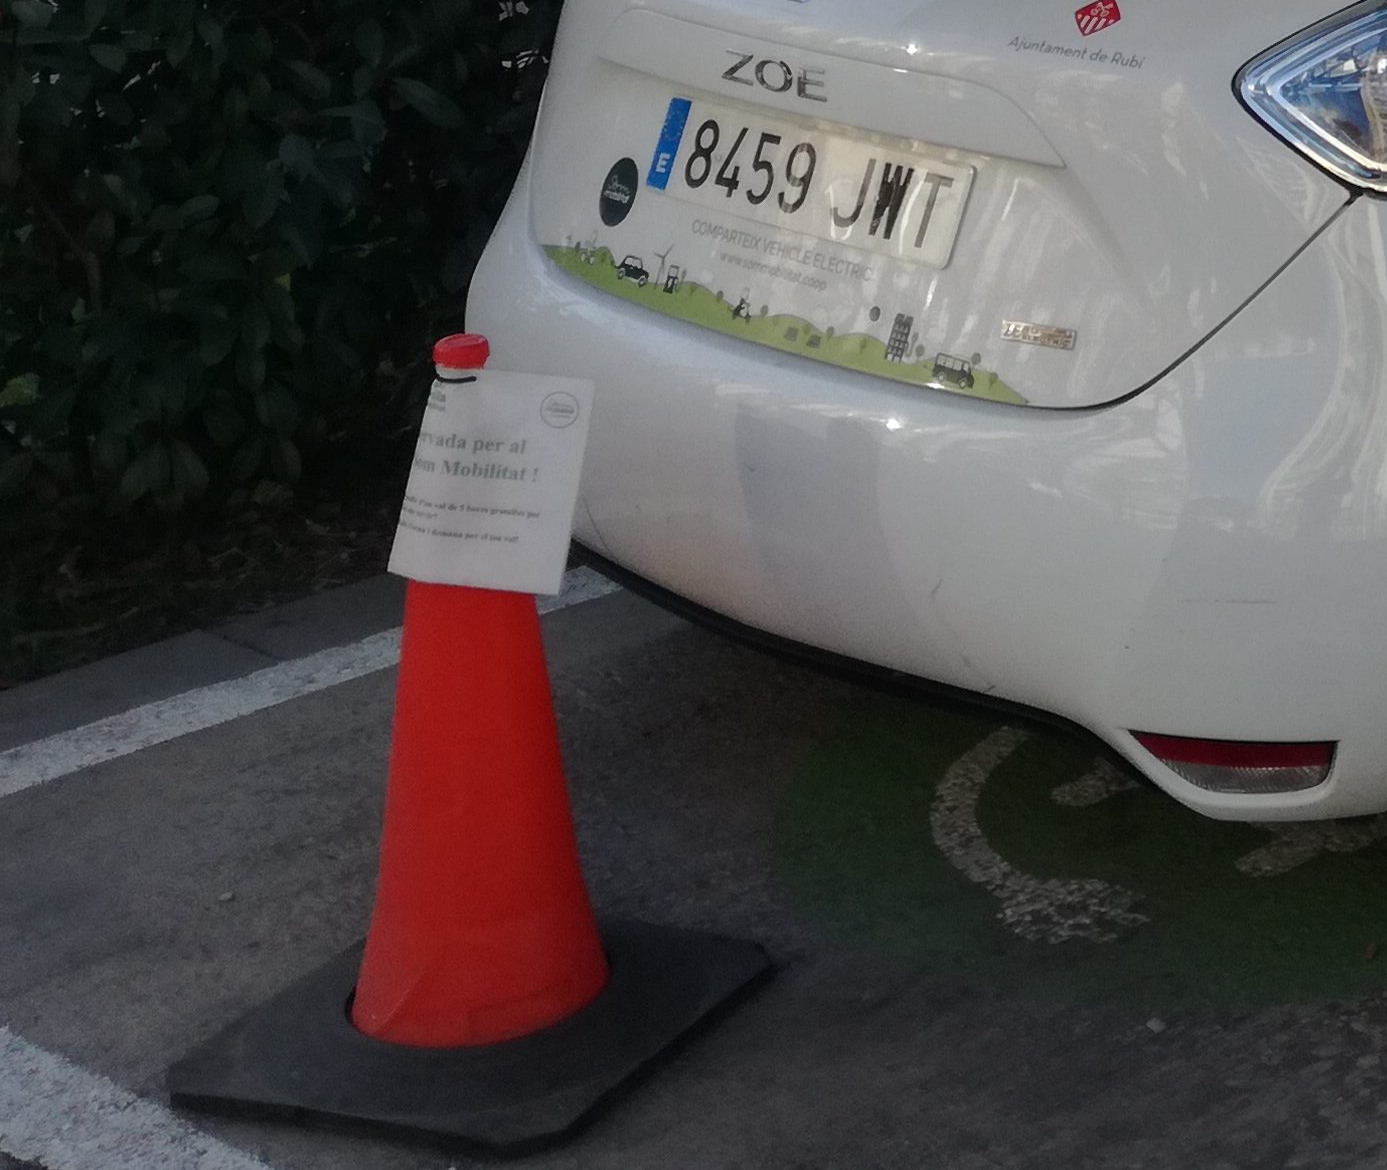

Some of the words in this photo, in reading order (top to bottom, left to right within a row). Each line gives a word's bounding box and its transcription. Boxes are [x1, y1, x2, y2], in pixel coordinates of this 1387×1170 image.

[1008, 36, 1087, 60] Ajuntament
[1089, 48, 1108, 63] de
[721, 49, 828, 103] ZOE
[655, 152, 671, 174] E
[684, 118, 817, 215] 8459
[691, 218, 760, 252] COMPARTEIX
[761, 236, 812, 266] VEHICLE
[472, 439, 505, 455] per
[509, 439, 527, 455] al
[442, 460, 526, 481] Mobilitat
